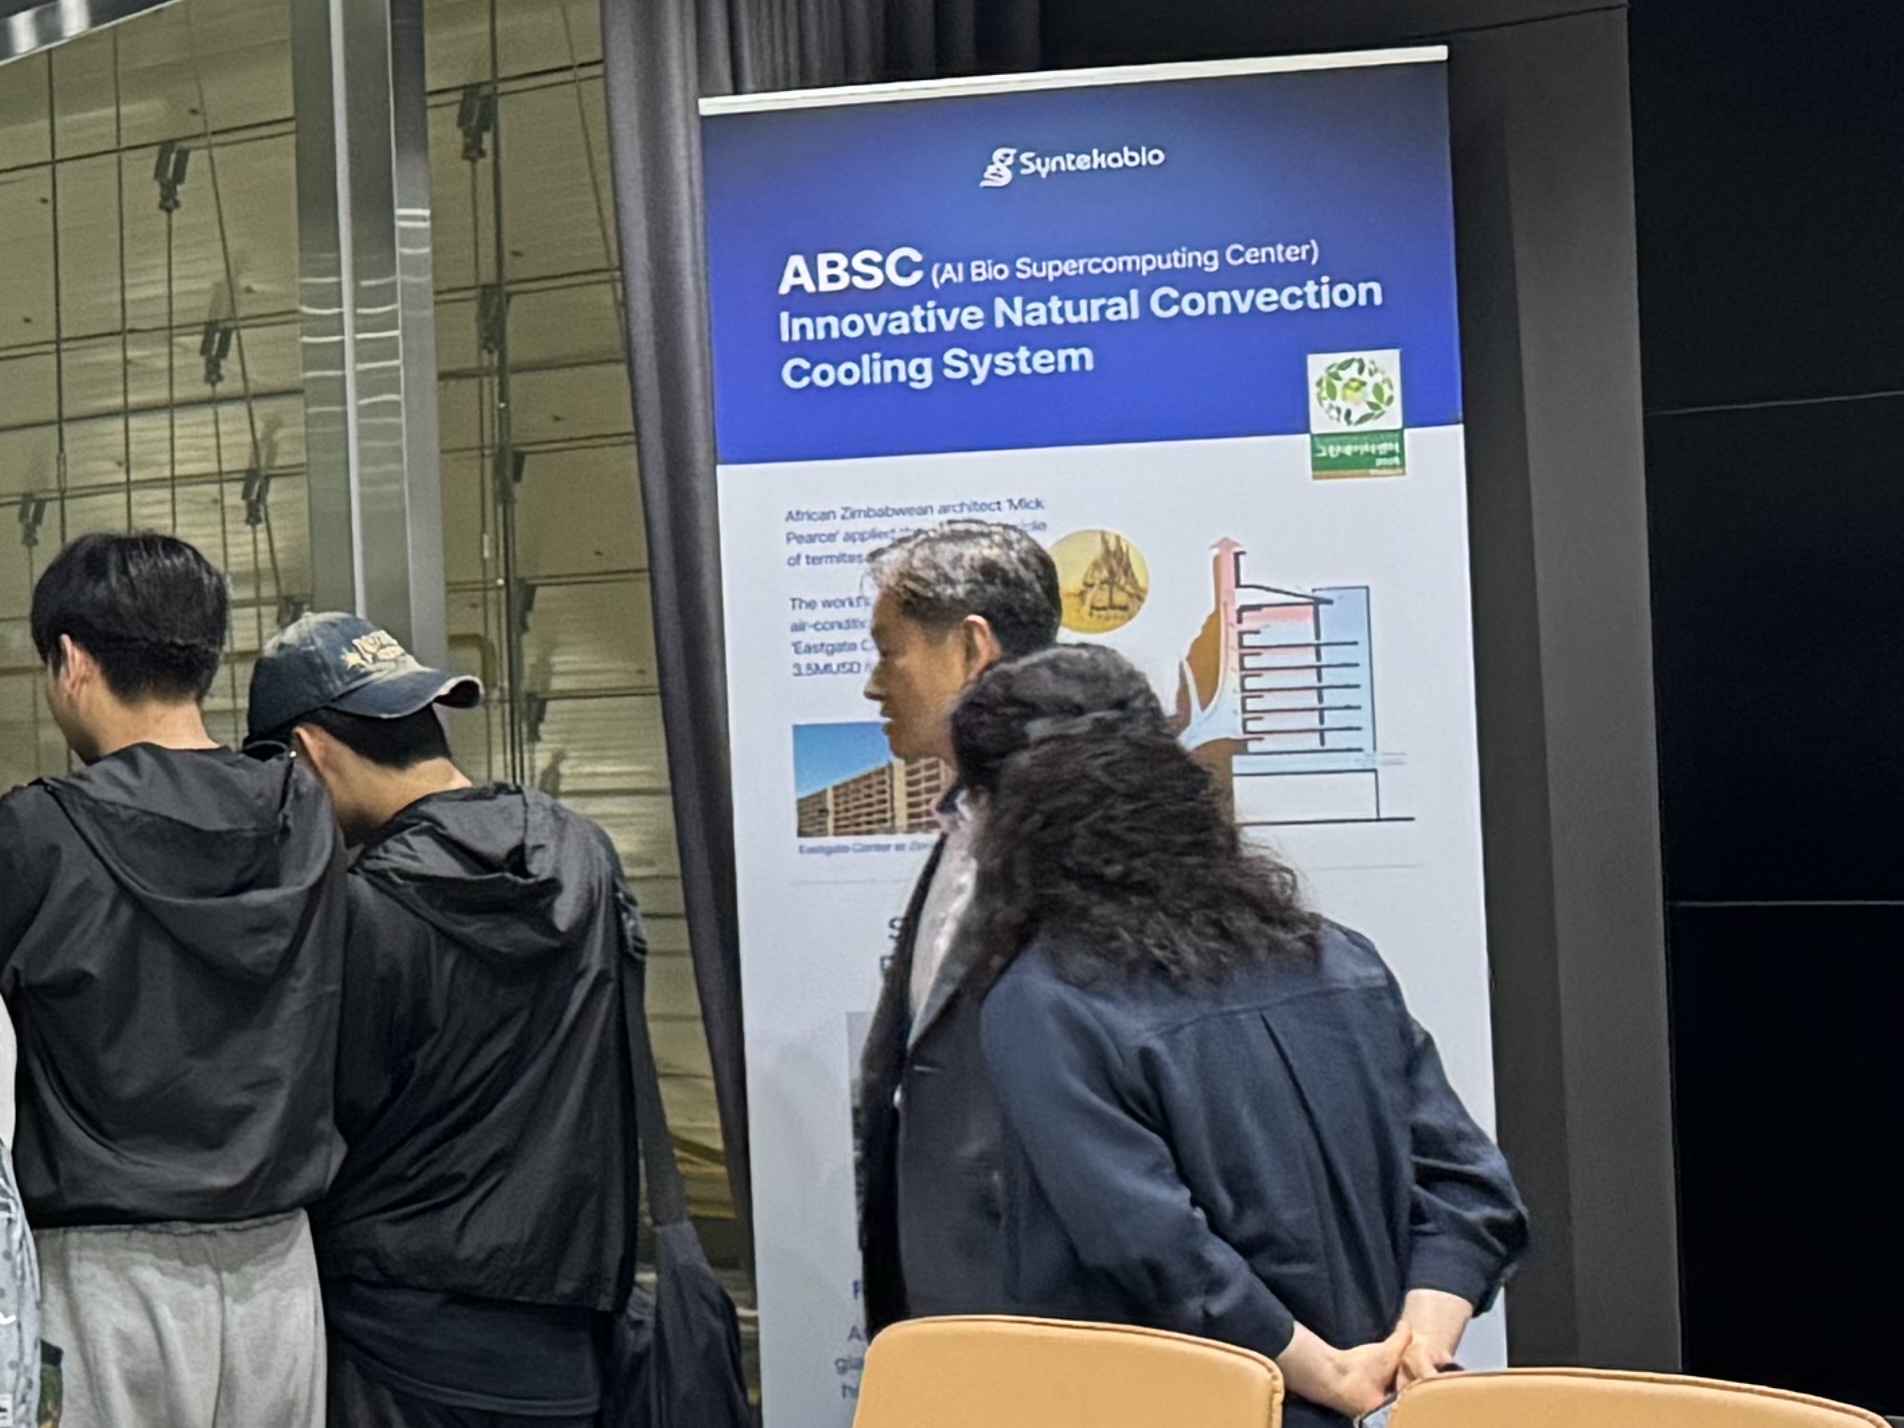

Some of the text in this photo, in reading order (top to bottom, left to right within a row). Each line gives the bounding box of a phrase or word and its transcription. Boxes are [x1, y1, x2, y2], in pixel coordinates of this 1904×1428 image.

[778, 239, 1319, 295] ABSC (AI Bio Supercomputing Center)
[779, 275, 1383, 342] Innovative Natural Convection
[782, 345, 1094, 390] Cooling System
